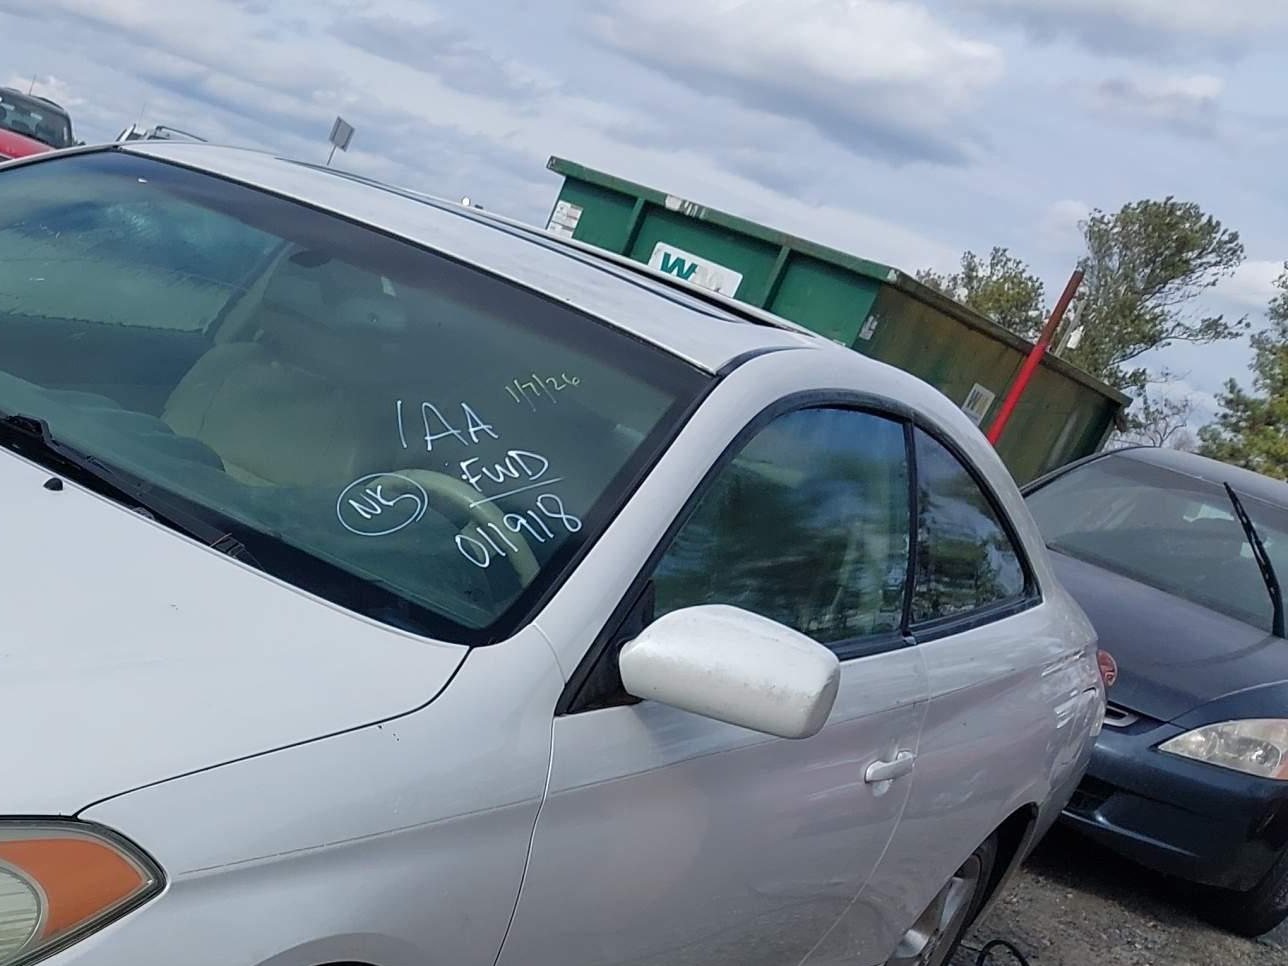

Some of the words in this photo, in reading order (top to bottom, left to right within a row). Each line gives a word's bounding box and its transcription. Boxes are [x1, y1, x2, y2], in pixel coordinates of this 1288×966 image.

[396, 400, 499, 450] IAA
[460, 450, 549, 492] FWD
[455, 494, 582, 568] 011918
